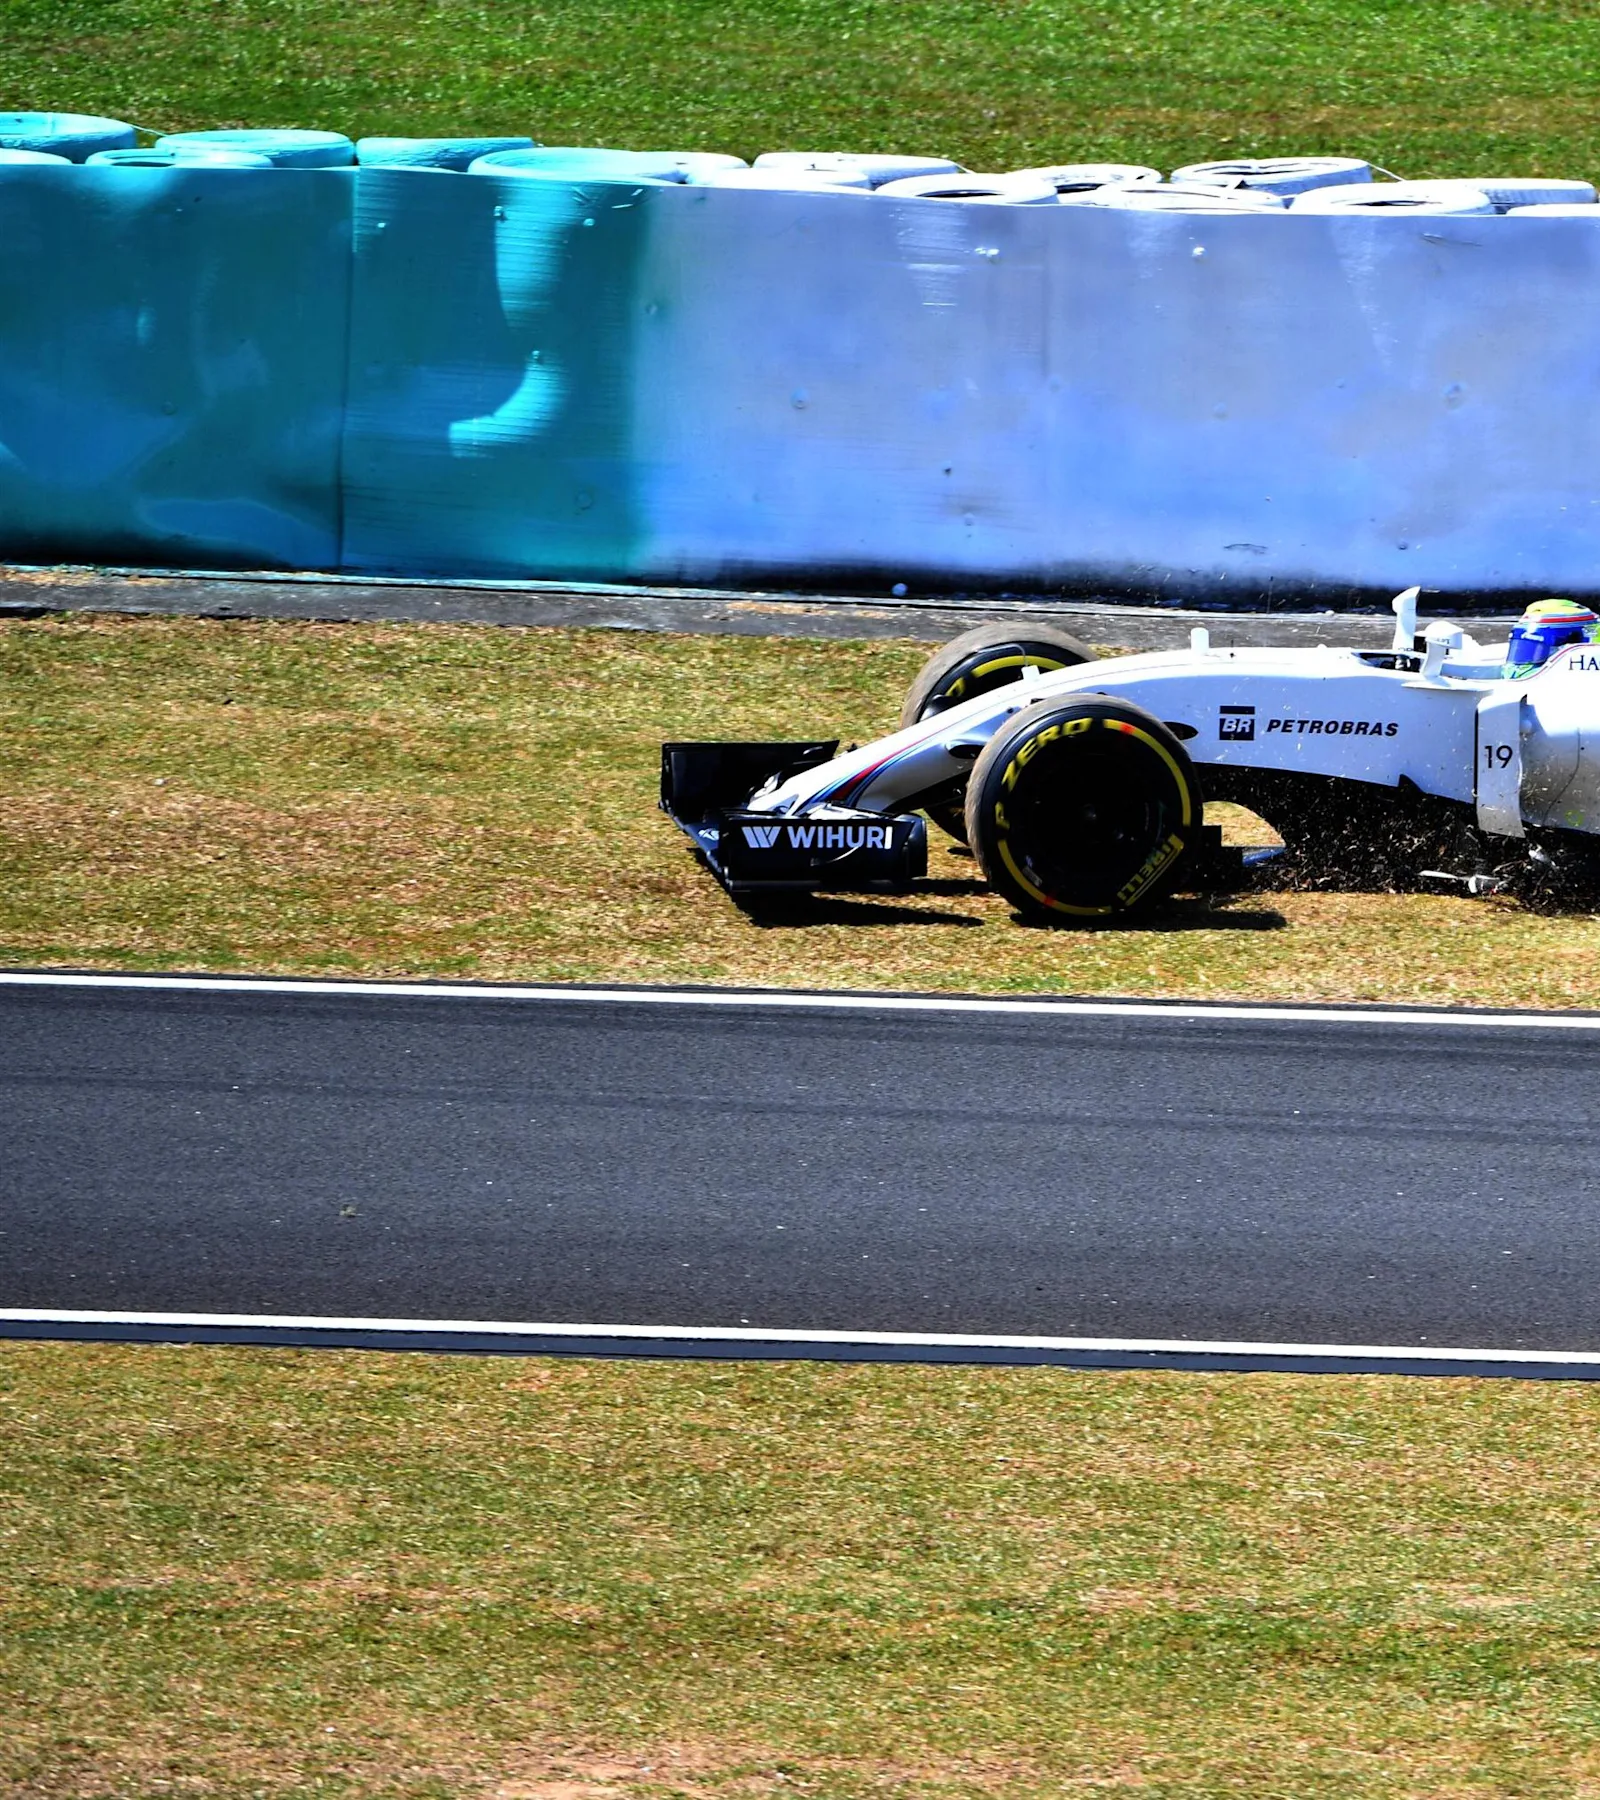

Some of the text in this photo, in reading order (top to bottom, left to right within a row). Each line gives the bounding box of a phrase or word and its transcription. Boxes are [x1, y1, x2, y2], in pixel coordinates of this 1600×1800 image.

[1222, 718, 1399, 737] BR PETROBRAS
[1001, 717, 1094, 793] ZERO
[1484, 744, 1513, 770] 19
[787, 826, 894, 850] WIHURI
[1116, 833, 1185, 907] PIRELLI
